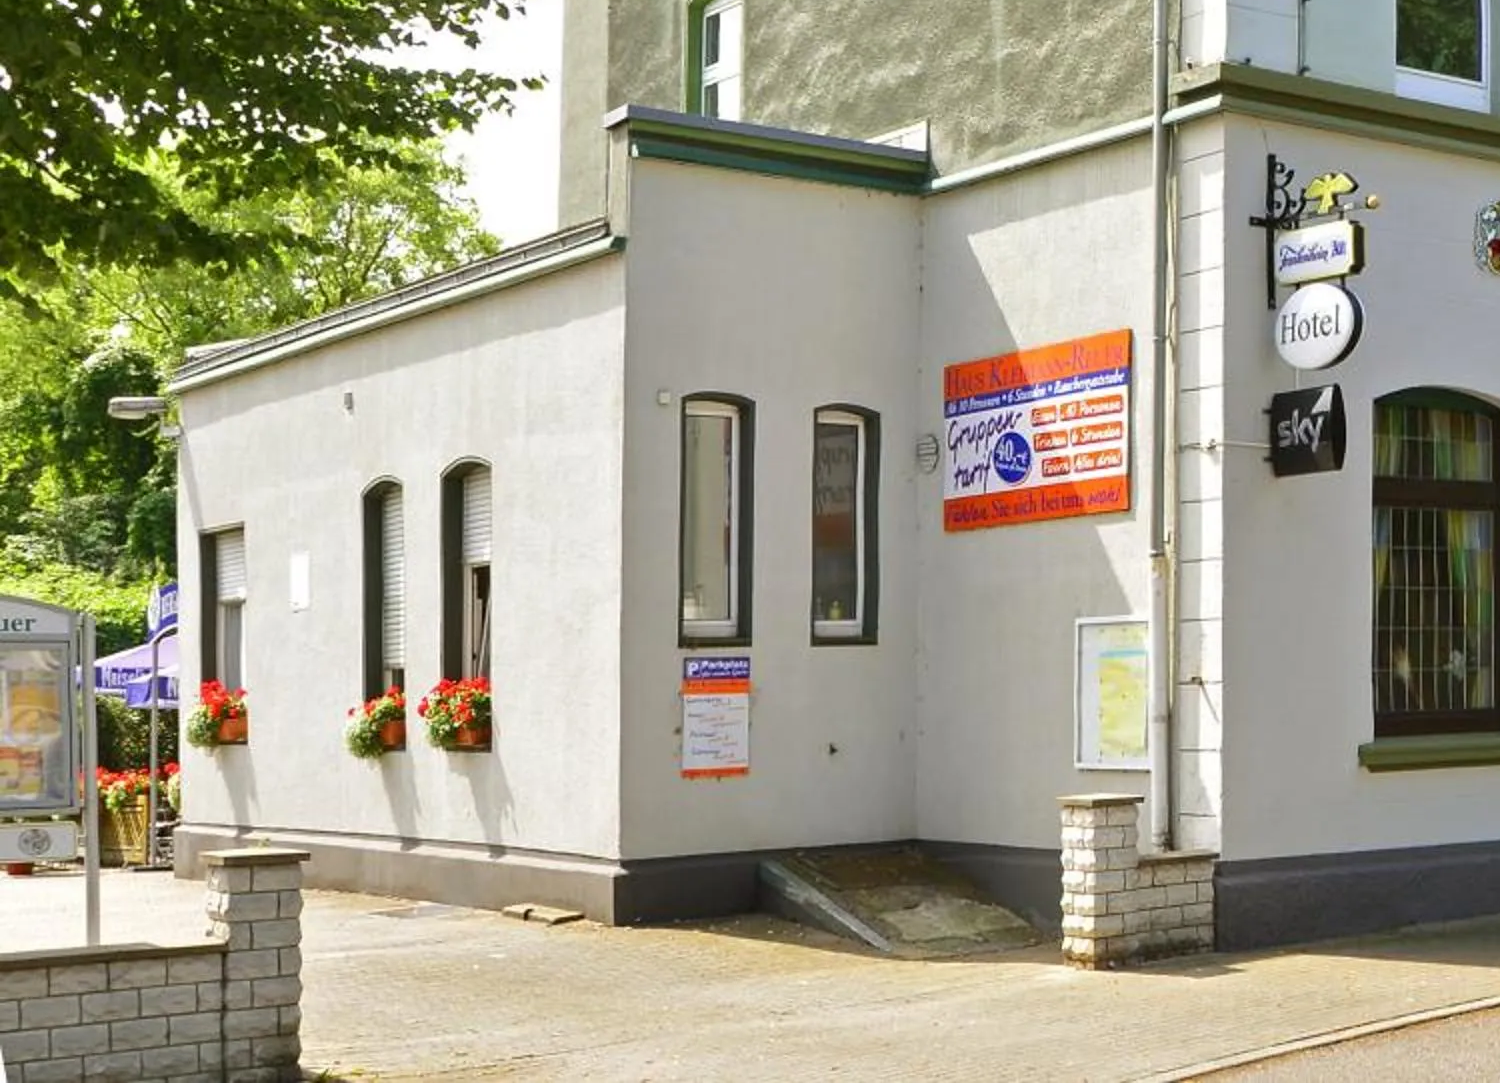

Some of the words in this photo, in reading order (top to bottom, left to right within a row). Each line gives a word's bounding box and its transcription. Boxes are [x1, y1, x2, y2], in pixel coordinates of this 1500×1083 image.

[1279, 242, 1329, 272] Frankenheim
[1331, 239, 1346, 259] Alt
[1280, 305, 1340, 345] Hotel
[1277, 408, 1323, 452] sky
[688, 661, 699, 677] P
